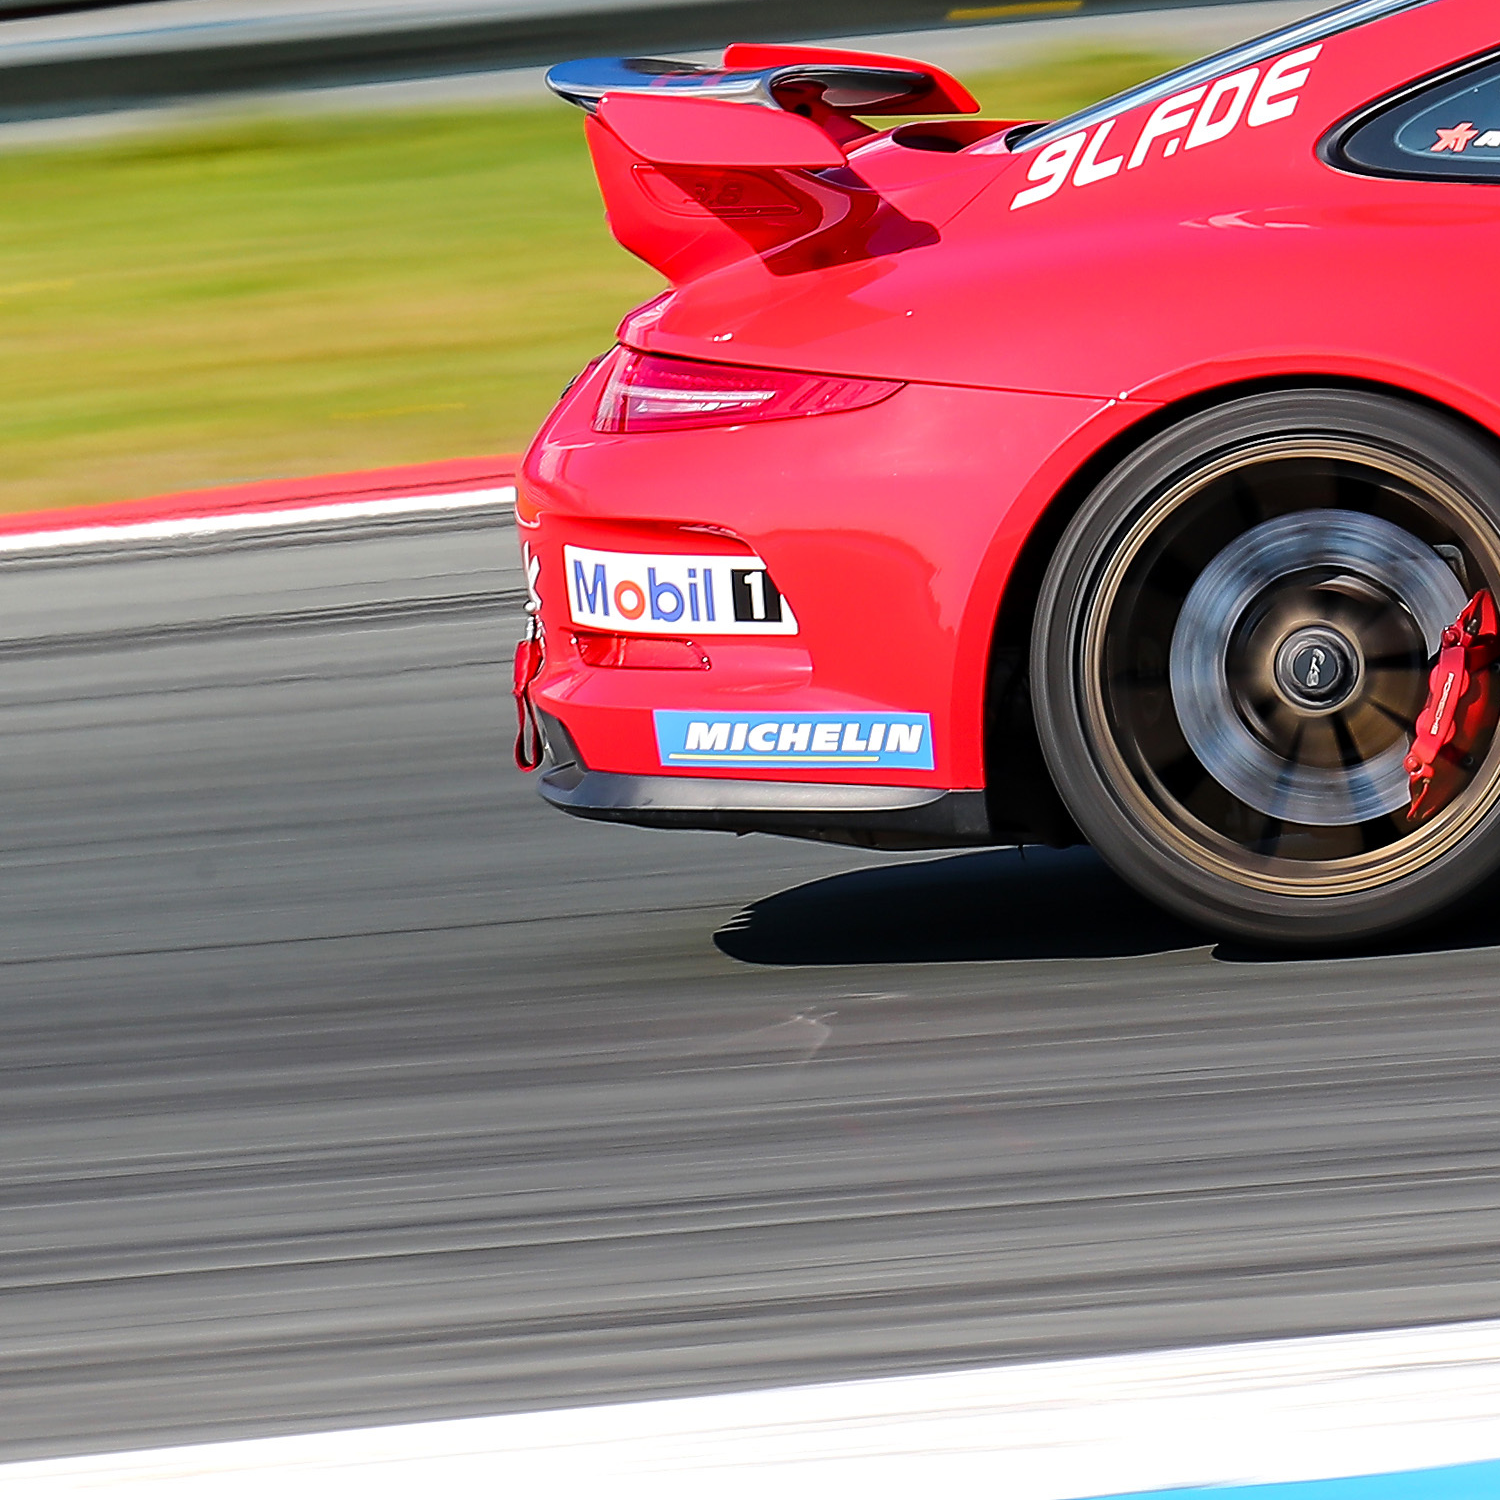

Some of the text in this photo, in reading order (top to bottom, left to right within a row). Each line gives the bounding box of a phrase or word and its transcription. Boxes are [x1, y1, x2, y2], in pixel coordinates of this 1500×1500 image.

[574, 560, 716, 623] Mobil
[743, 571, 765, 619] 1
[1430, 672, 1455, 735] PORSCHE
[684, 722, 924, 753] MICHELIN
